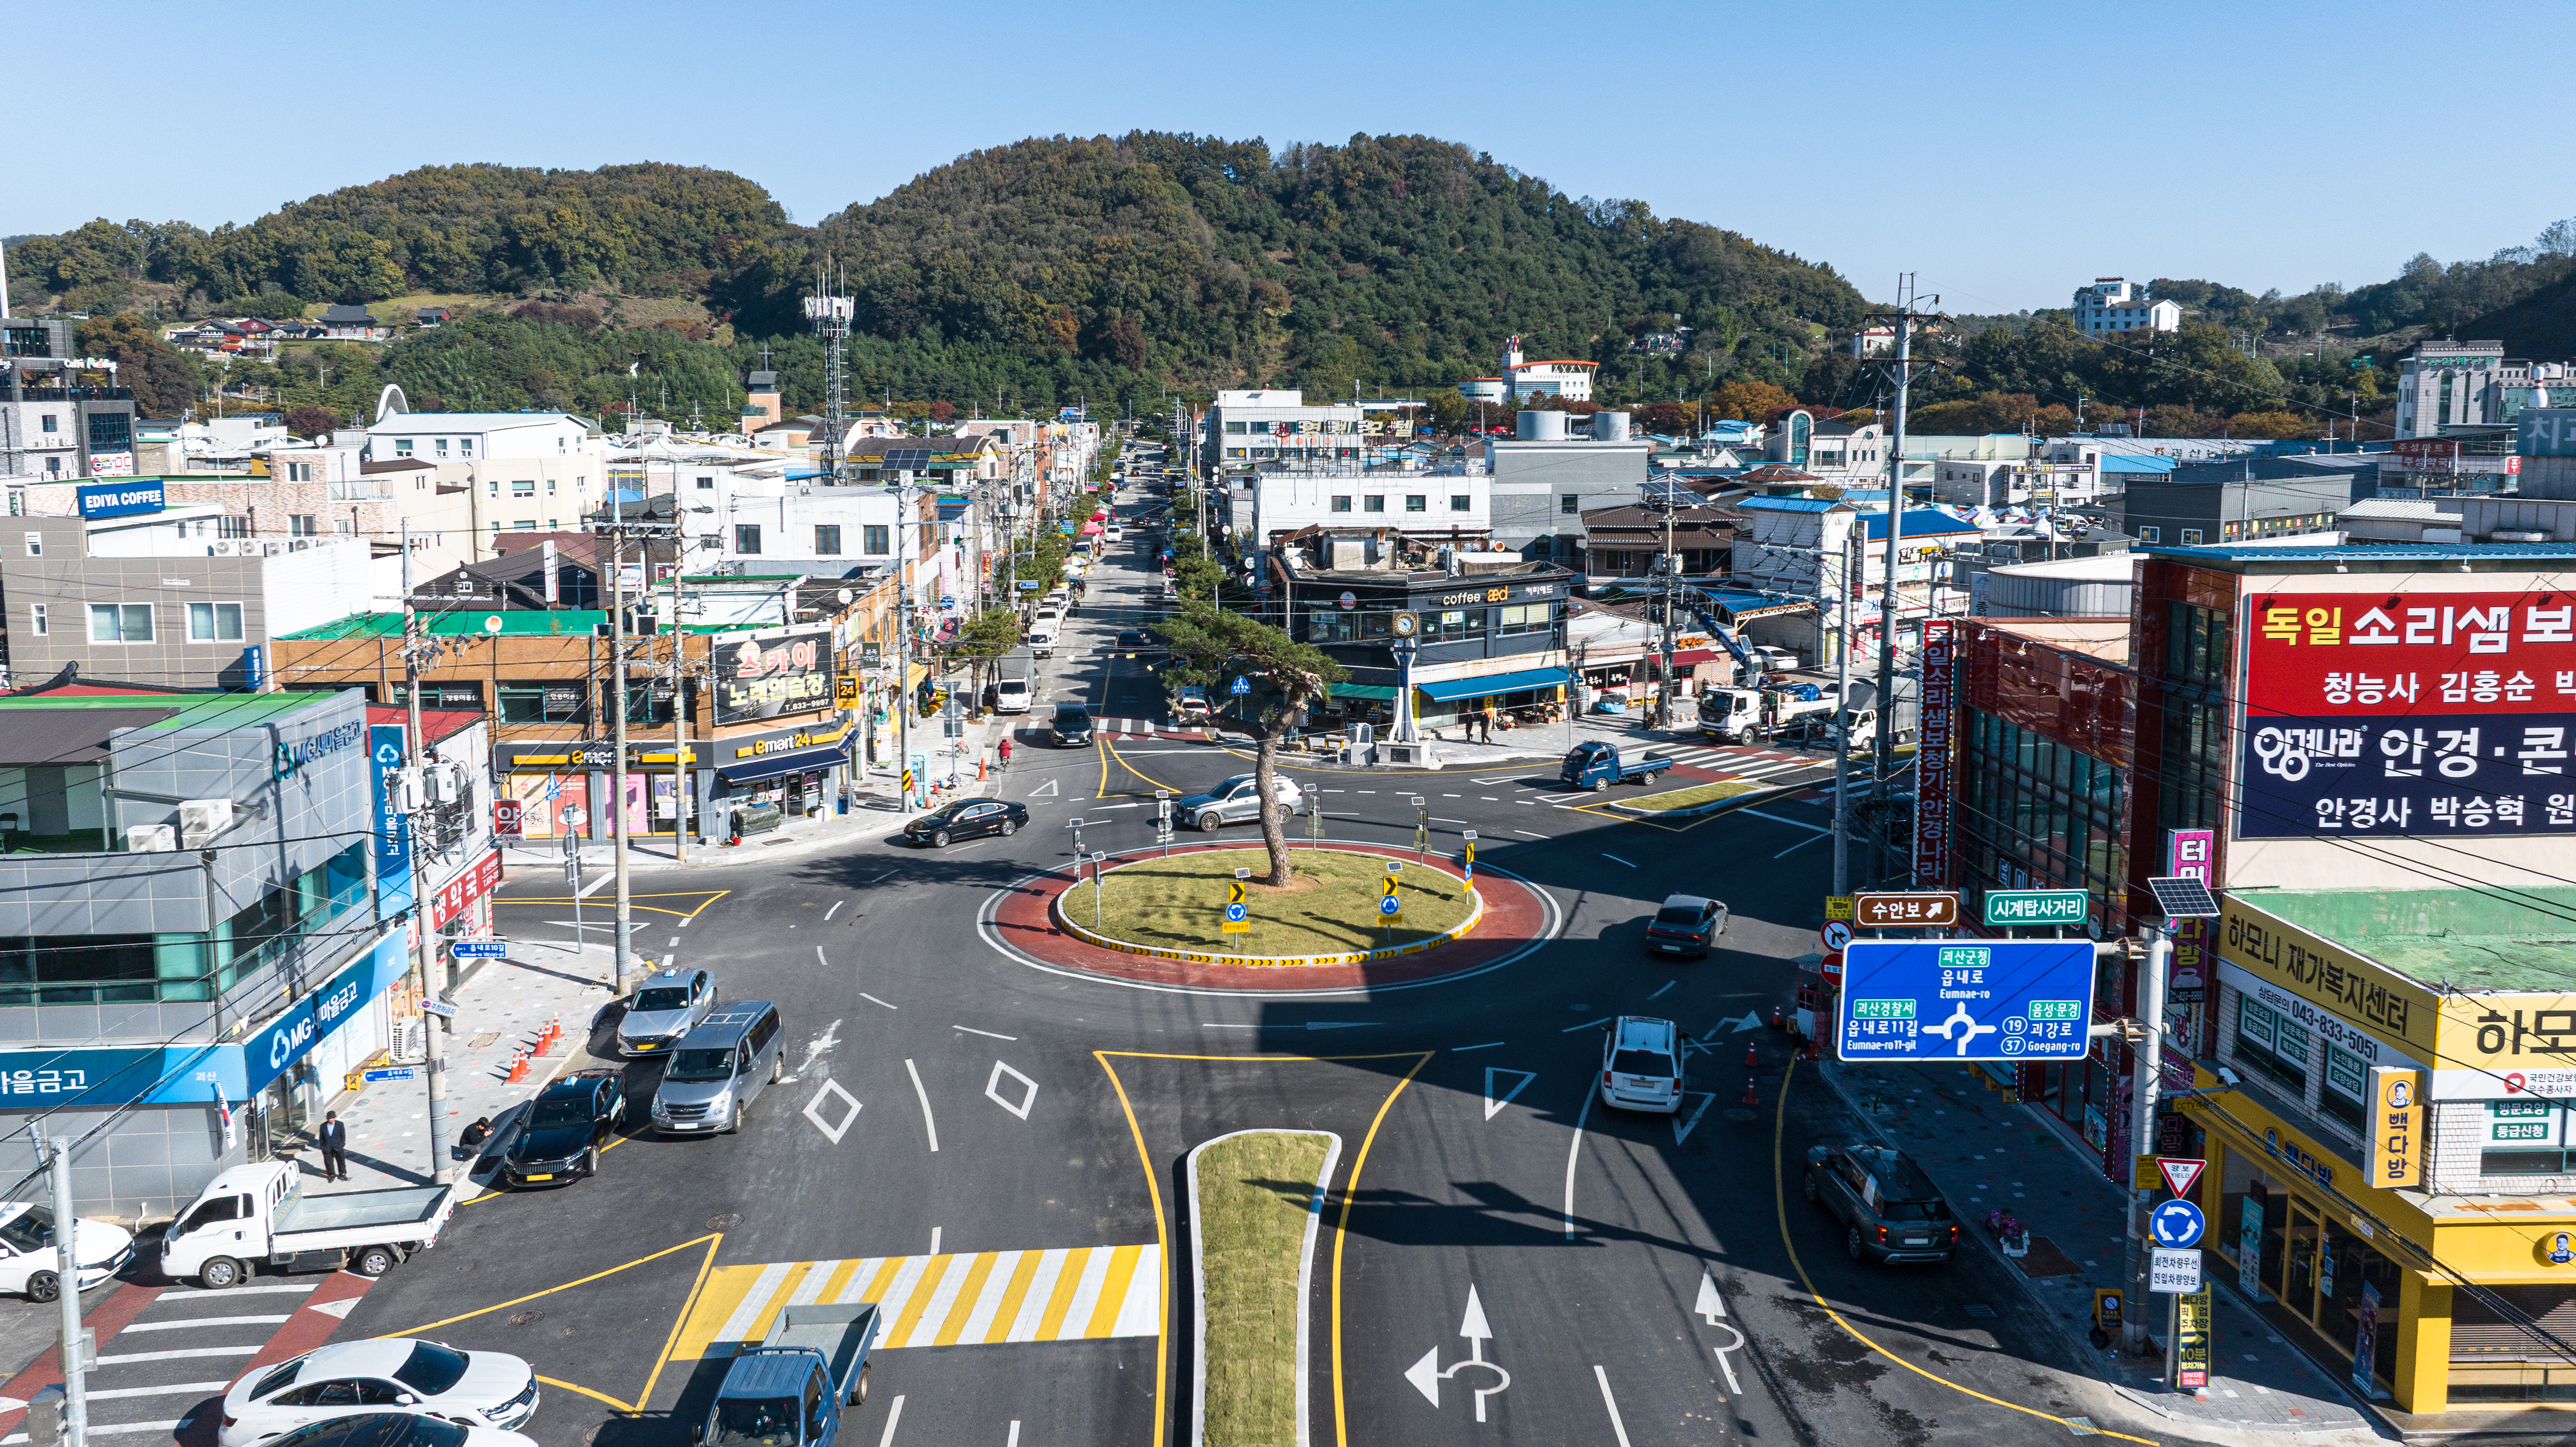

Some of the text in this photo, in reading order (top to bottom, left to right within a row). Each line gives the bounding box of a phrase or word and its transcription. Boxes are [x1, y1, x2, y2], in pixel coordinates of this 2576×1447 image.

[2426, 356, 2496, 366] 농협웨딩홀
[1302, 420, 1414, 438] 영빈모텔
[2399, 442, 2444, 452] 주성마트
[85, 489, 162, 509] EDIYA COFFEE
[1443, 592, 1481, 606] coffee
[1525, 585, 1553, 596] 커피애드
[2261, 607, 2343, 646] 독일
[2349, 606, 2510, 654] 소리샘
[737, 639, 817, 678] 스카이
[730, 673, 826, 708] 노래연습장
[840, 685, 855, 696] 24
[2322, 671, 2420, 704] 청능사
[2439, 669, 2536, 704] 김홍순
[785, 698, 830, 711] T.833-9997
[293, 719, 363, 768] MG새마을금고
[755, 732, 810, 754] emart24
[497, 806, 520, 830] 약
[2315, 796, 2412, 829] 안경사
[2430, 795, 2524, 828] 박승혁
[1872, 902, 1921, 919] 수안보
[1994, 898, 2081, 918] 시계탑사거리
[1942, 950, 1988, 966] 괴산군청
[1941, 969, 1984, 986] 읍내로
[2228, 913, 2408, 1037] 하모니 재가복지센터
[1940, 988, 1990, 1000] Eumnae-ro
[290, 980, 359, 1050] MG새마을금고
[430, 1002, 456, 1016] 주정차금지
[1857, 1001, 1913, 1017] 괴산경찰서
[2248, 1001, 2270, 1021] 방문요양
[1847, 1020, 1918, 1038] 읍내로11길
[2008, 1020, 2022, 1032] 19
[2031, 1022, 2073, 1038] 괴강로
[2247, 1019, 2269, 1039] 등급신청
[2258, 986, 2378, 1063] 상담문의 043-833-5051
[2283, 1021, 2307, 1043] 방문목욕
[2005, 1040, 2020, 1051] 37
[2028, 1041, 2081, 1052] Goegang-ro
[2282, 1040, 2306, 1061] 복지용구
[2334, 1050, 2360, 1073] 노인돌봄
[195, 1071, 216, 1082] 괴산
[2333, 1070, 2359, 1092] 요양상담
[2529, 1085, 2572, 1094] 우수종사자
[2499, 1103, 2546, 1115] 방문요양
[2496, 1125, 2544, 1138] 등급신청
[2387, 1111, 2409, 1179] 빽다방
[2154, 1255, 2197, 1270] 회전차량우선
[2153, 1272, 2197, 1286] 진입차량양보
[2181, 1319, 2209, 1329] 주차장
[2181, 1347, 2207, 1361] 10분
[2181, 1362, 2207, 1370] 정차가능
